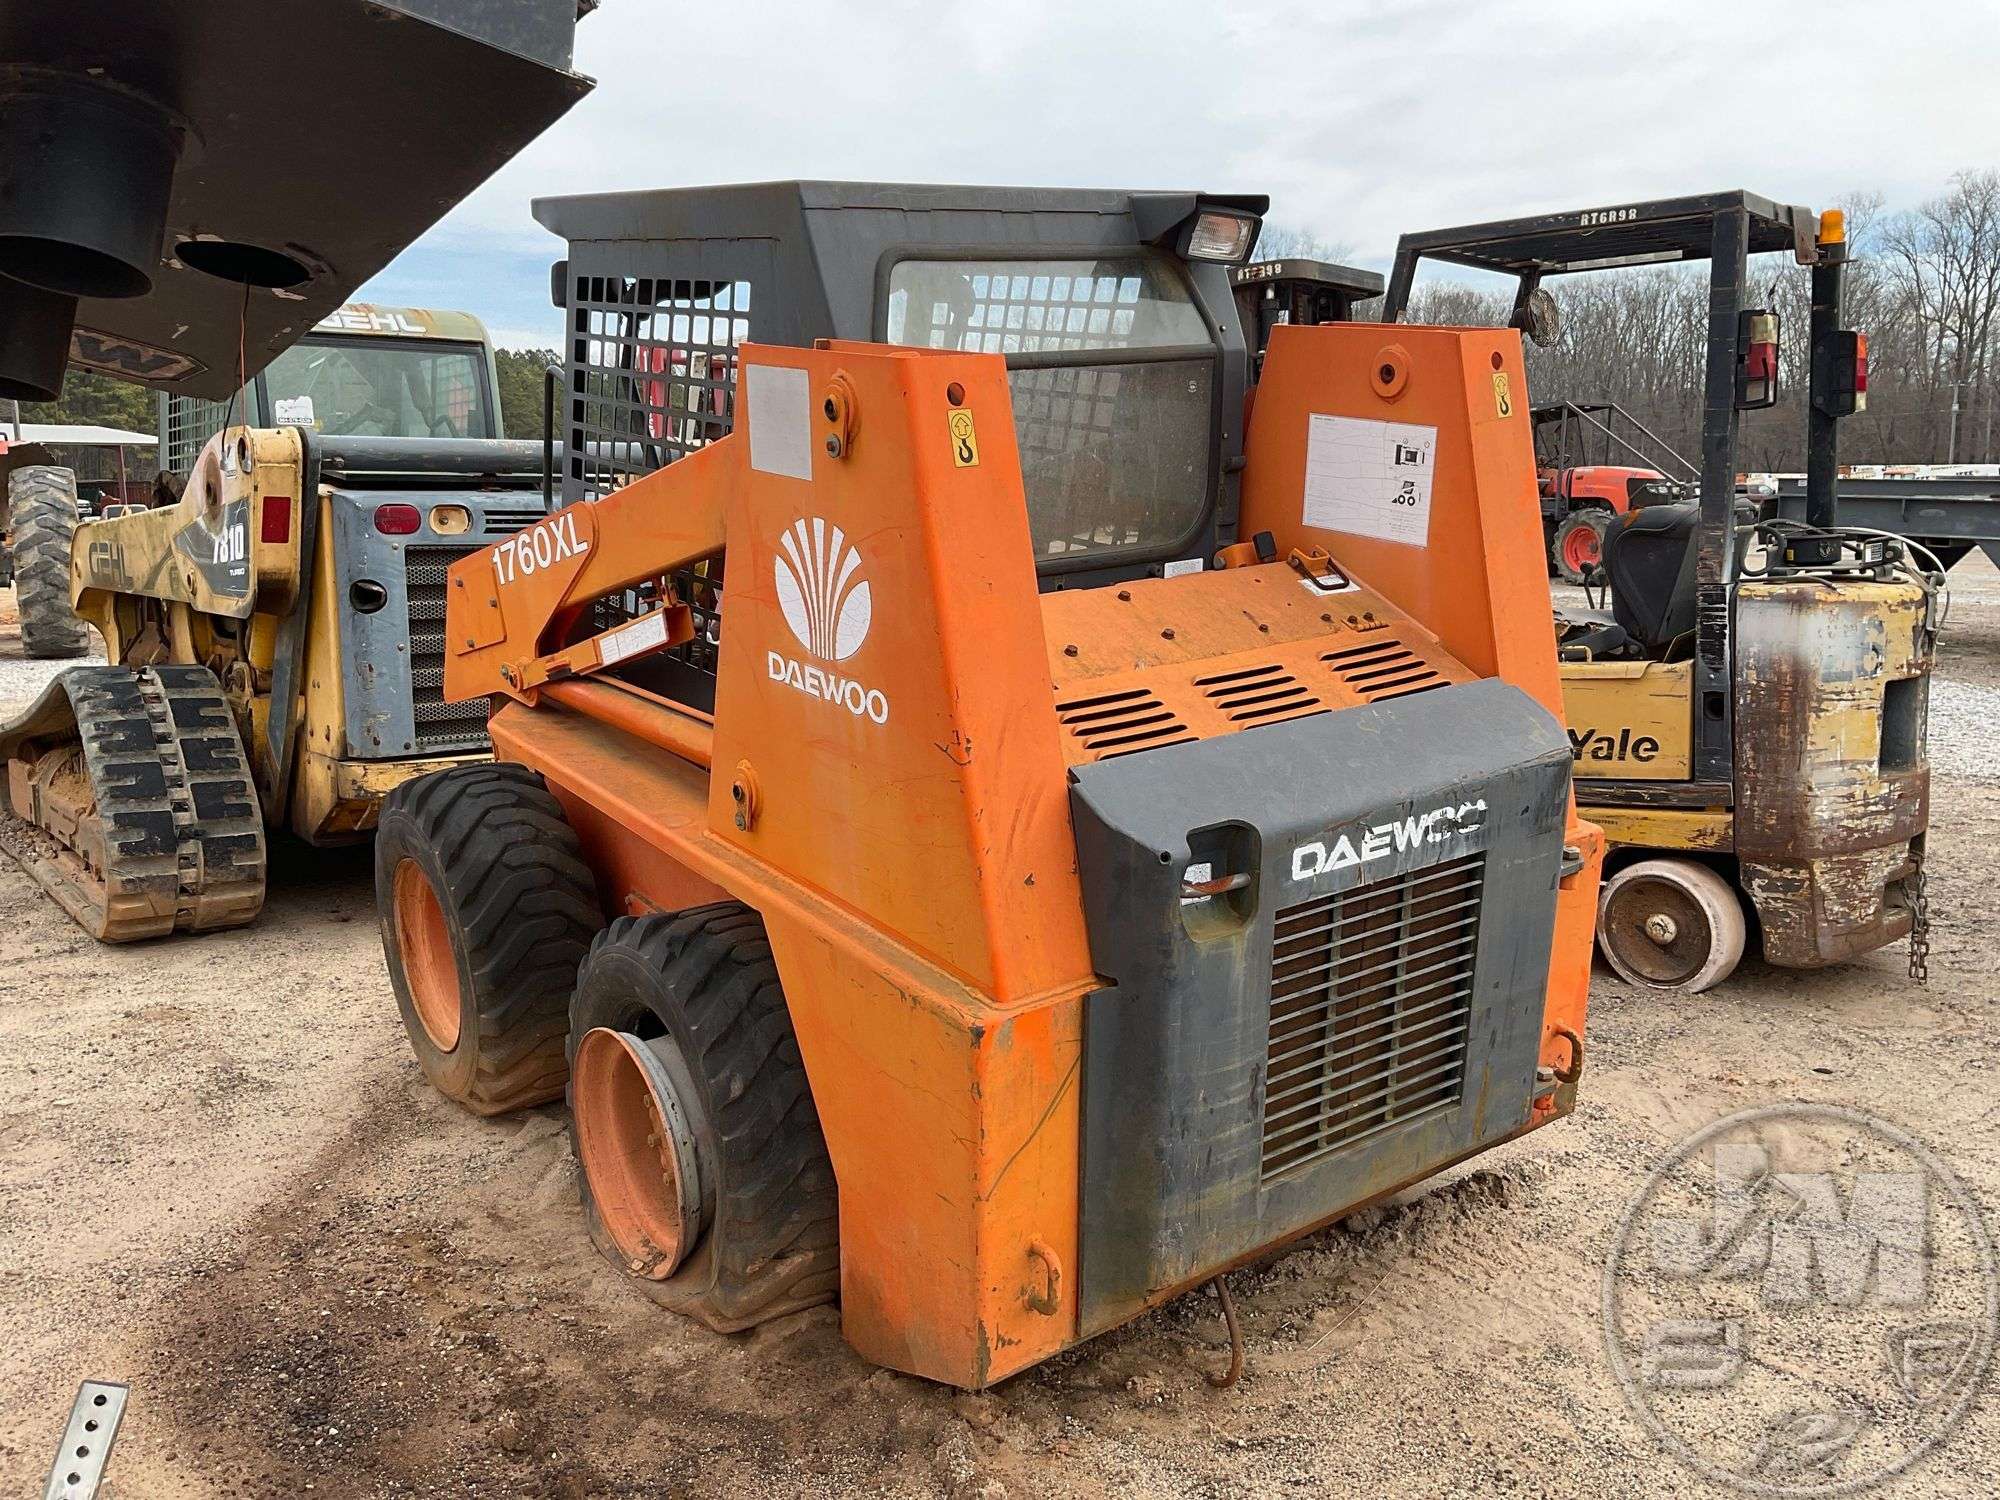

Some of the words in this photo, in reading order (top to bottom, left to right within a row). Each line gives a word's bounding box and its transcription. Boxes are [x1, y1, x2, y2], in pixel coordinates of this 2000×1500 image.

[491, 511, 590, 586] 1760XL
[767, 650, 889, 725] DAEWOO
[1567, 727, 1660, 763] Yale
